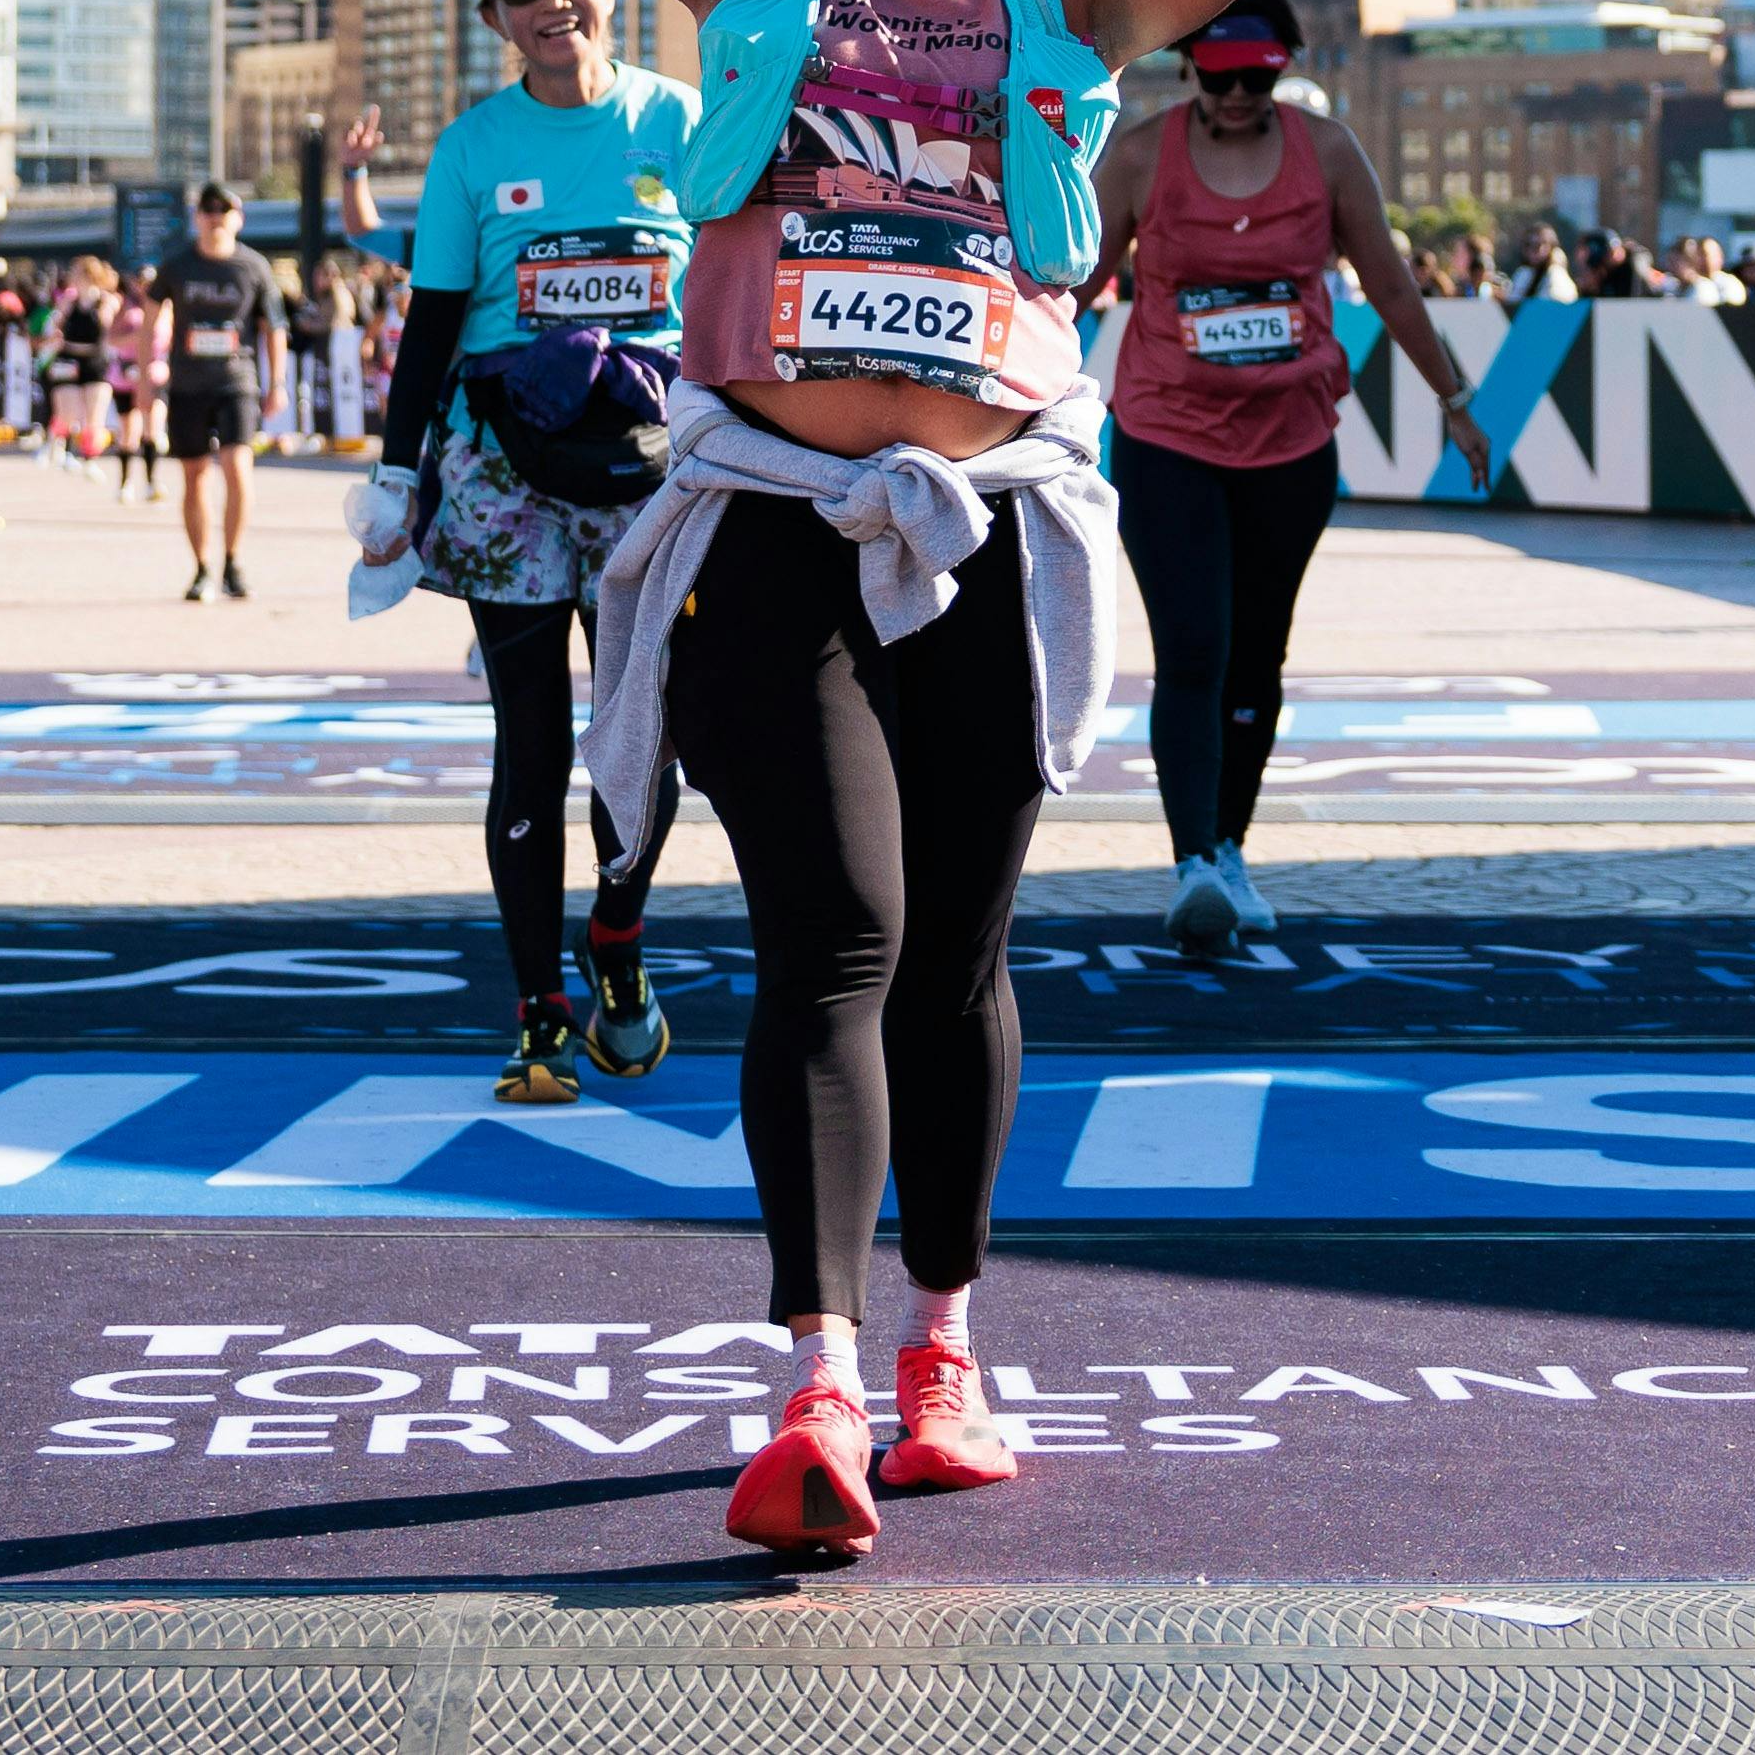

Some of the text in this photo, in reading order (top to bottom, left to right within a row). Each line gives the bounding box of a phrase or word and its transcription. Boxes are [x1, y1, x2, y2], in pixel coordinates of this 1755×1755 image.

[1038, 104, 1064, 115] CLIF
[850, 223, 881, 234] TATA
[798, 229, 845, 253] tcs
[848, 233, 920, 248] CONSULTANCY
[848, 244, 894, 256] SERVICES
[540, 275, 644, 303] 44084
[779, 301, 794, 321] 3
[810, 288, 974, 345] 44262
[989, 321, 1004, 343] G
[1204, 316, 1284, 343] 44376
[562, 943, 1644, 975] SNEY
[36, 1414, 1283, 1457] SERVIES
